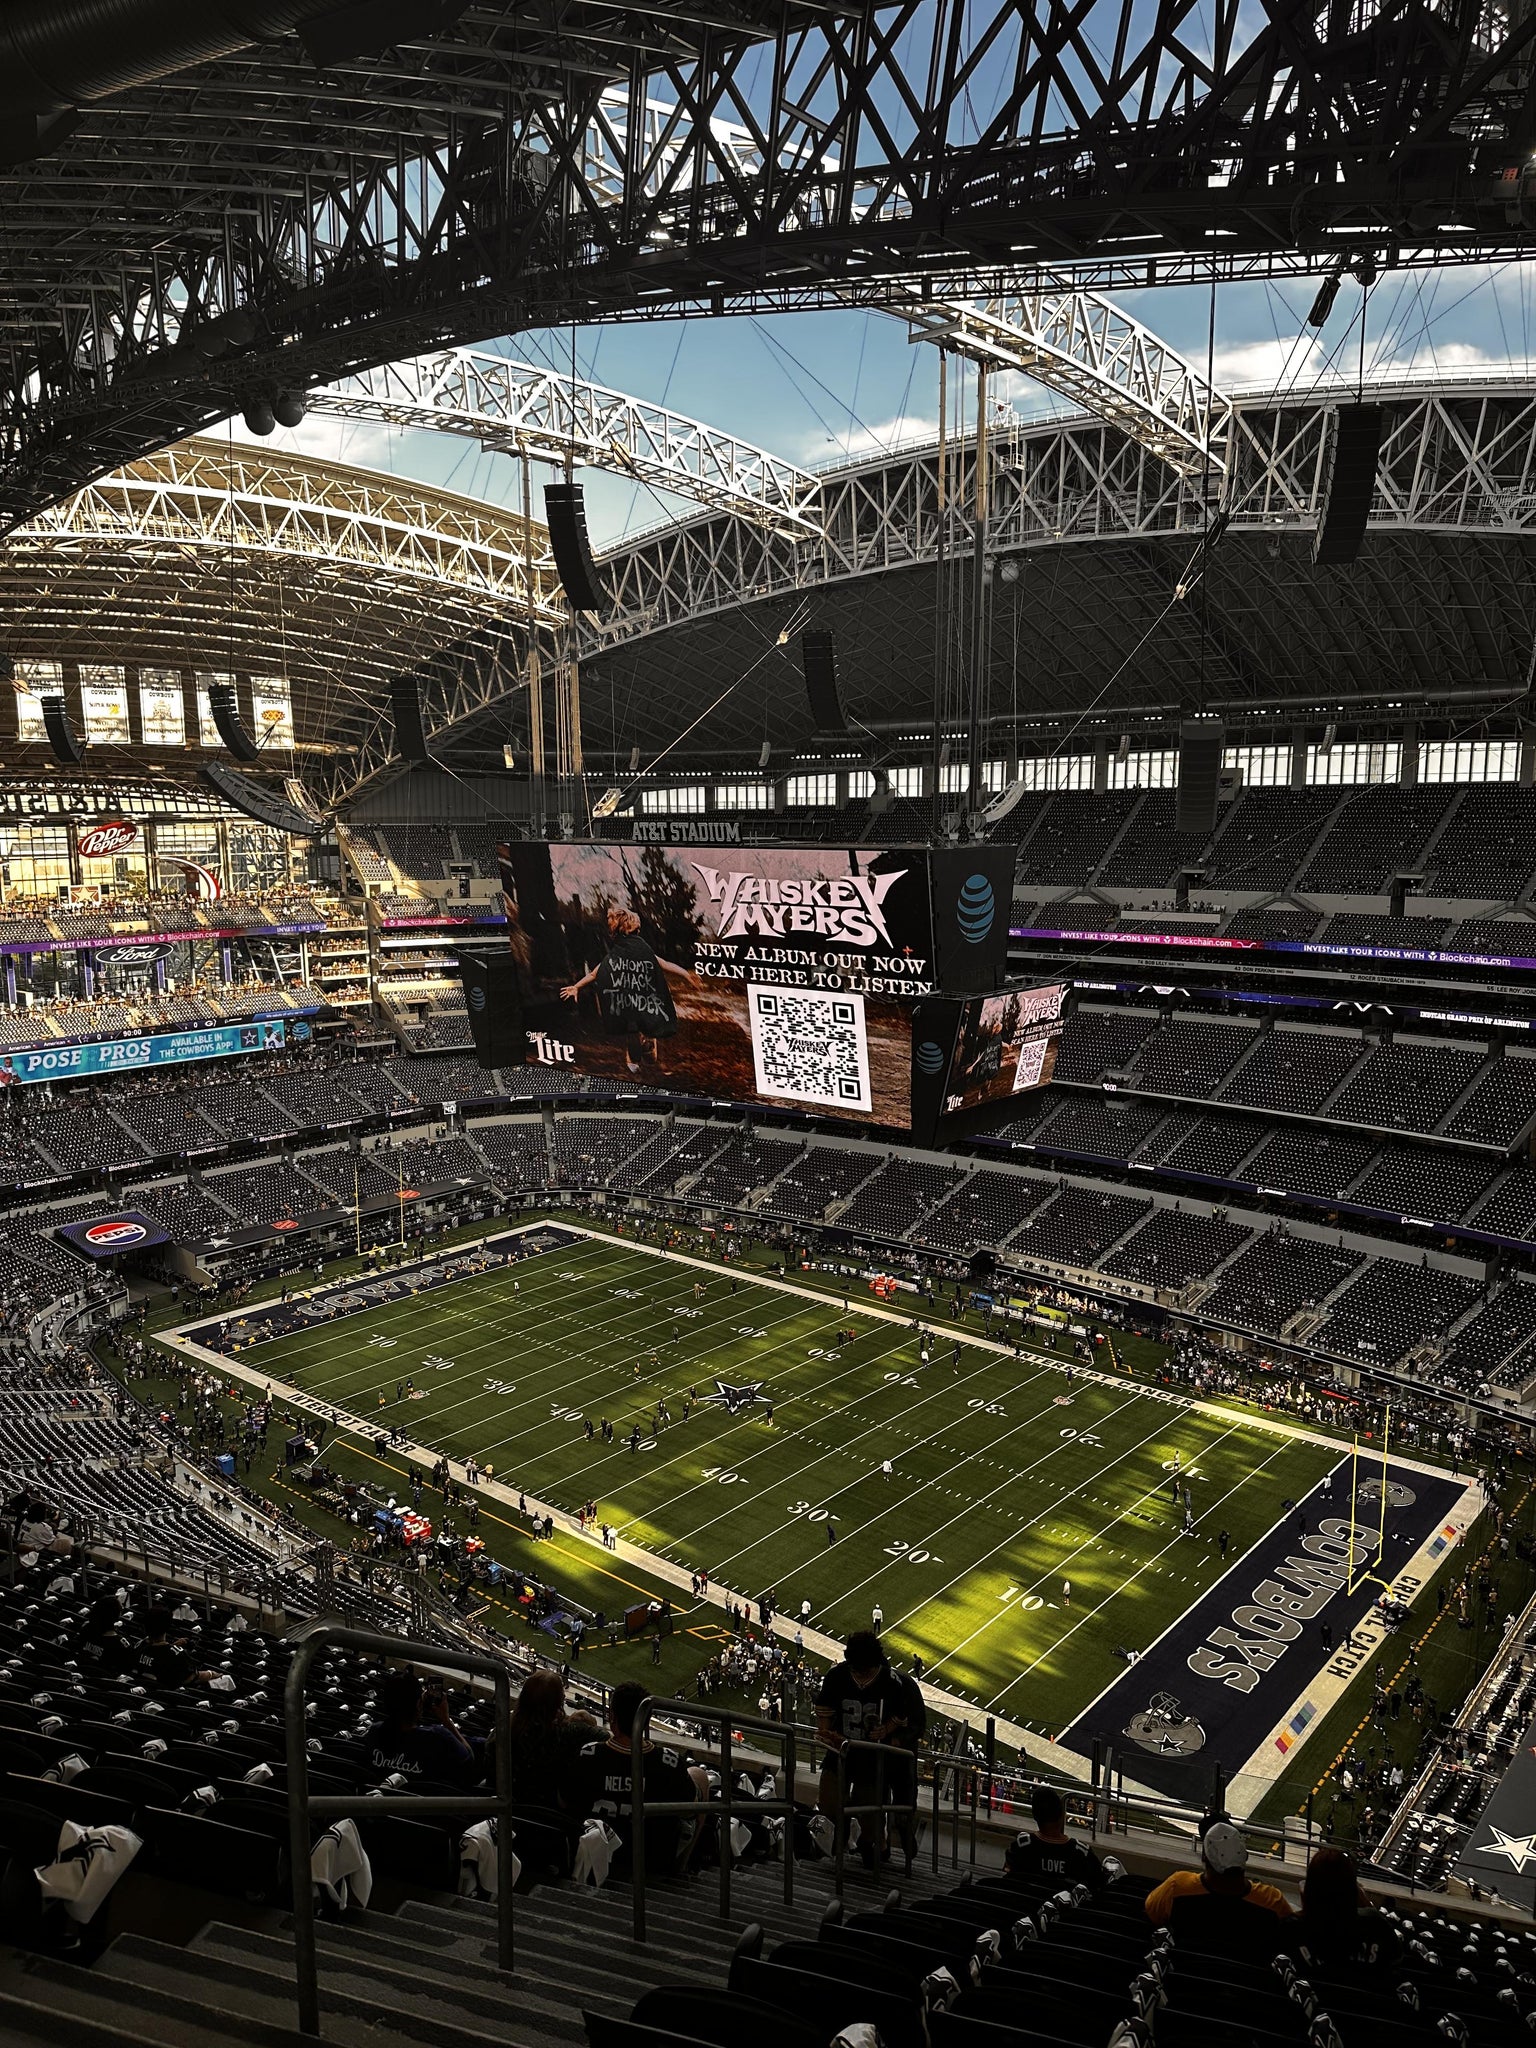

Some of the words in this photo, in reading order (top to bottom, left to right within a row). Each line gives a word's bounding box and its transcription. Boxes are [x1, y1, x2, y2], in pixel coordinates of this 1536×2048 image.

[105, 827, 125, 840] Dr
[632, 821, 667, 840] AT&T
[670, 822, 741, 842] STADIUM
[85, 830, 135, 854] Pepper
[691, 862, 908, 940] WHISKEY
[277, 925, 297, 933] INVEST
[722, 903, 878, 946] MYERS
[50, 941, 75, 950] INVEST
[77, 940, 92, 948] LIKE
[94, 939, 113, 947] YOUR
[115, 937, 137, 945] ICONS
[167, 930, 220, 941] Blockchain.com
[1084, 932, 1098, 940] LIKE
[1173, 937, 1231, 947] Blockchain.com
[110, 945, 157, 961] Ford
[694, 942, 739, 959] NEW
[744, 946, 818, 966] ALBUM
[824, 952, 866, 970] OUT
[872, 955, 926, 975] NOW
[1304, 945, 1330, 953] INVEST
[1350, 947, 1372, 956] YOUR
[1375, 949, 1400, 958] ICONS
[1440, 952, 1511, 965] Blockchain.com
[609, 957, 654, 974] WHOMP
[610, 972, 656, 992] WHACK
[694, 961, 745, 979] SCAN
[748, 965, 808, 985] HERE
[813, 971, 842, 989] TO
[848, 975, 932, 997] LISTEN
[603, 988, 670, 1021] THUNDER
[1027, 1006, 1058, 1024] MYERS
[1447, 1013, 1467, 1022] GRAND
[1468, 1015, 1483, 1023] PRIX
[1484, 1017, 1493, 1025] OF
[1493, 1019, 1530, 1029] ARLINGTON
[123, 1028, 142, 1037] 90:00
[171, 1034, 212, 1047] AVAILABLE
[214, 1032, 223, 1041] IN
[27, 1050, 83, 1072] POSE
[98, 1041, 152, 1062] PROS
[160, 1048, 175, 1058] THE
[176, 1043, 214, 1056] COWBOYS
[215, 1041, 234, 1051] APP!
[529, 1037, 574, 1065] Lite
[947, 1094, 964, 1111] Lite
[186, 1144, 229, 1157] Blockchain.com
[108, 1159, 154, 1172] Blockchain.com
[23, 1174, 73, 1188] Blockchain.com
[91, 1225, 142, 1242] PEPSI
[297, 1250, 503, 1317] COWBOYS
[614, 1289, 644, 1299] 20
[673, 1307, 703, 1318] 30
[738, 1326, 768, 1338] 40
[367, 1335, 398, 1348] 10
[422, 1357, 455, 1370] 20
[807, 1348, 841, 1362] 50
[483, 1380, 516, 1395] 30
[883, 1372, 918, 1387] 40
[1018, 1351, 1113, 1382] NTERCEPT
[1117, 1381, 1196, 1407] CANCER
[549, 1405, 583, 1421] 40
[967, 1398, 1005, 1414] 30
[1059, 1428, 1098, 1445] 20
[700, 1467, 739, 1484] 40
[1161, 1460, 1203, 1479] 10
[787, 1501, 829, 1522] 30
[883, 1541, 930, 1563] 20
[995, 1585, 1044, 1611] 10
[1187, 1518, 1383, 1694] COWBOYS
[1326, 1631, 1378, 1680] CATCH
[372, 1749, 423, 1774] Dallas
[605, 1775, 646, 1792] NELS
[1041, 1858, 1066, 1874] LOVE
